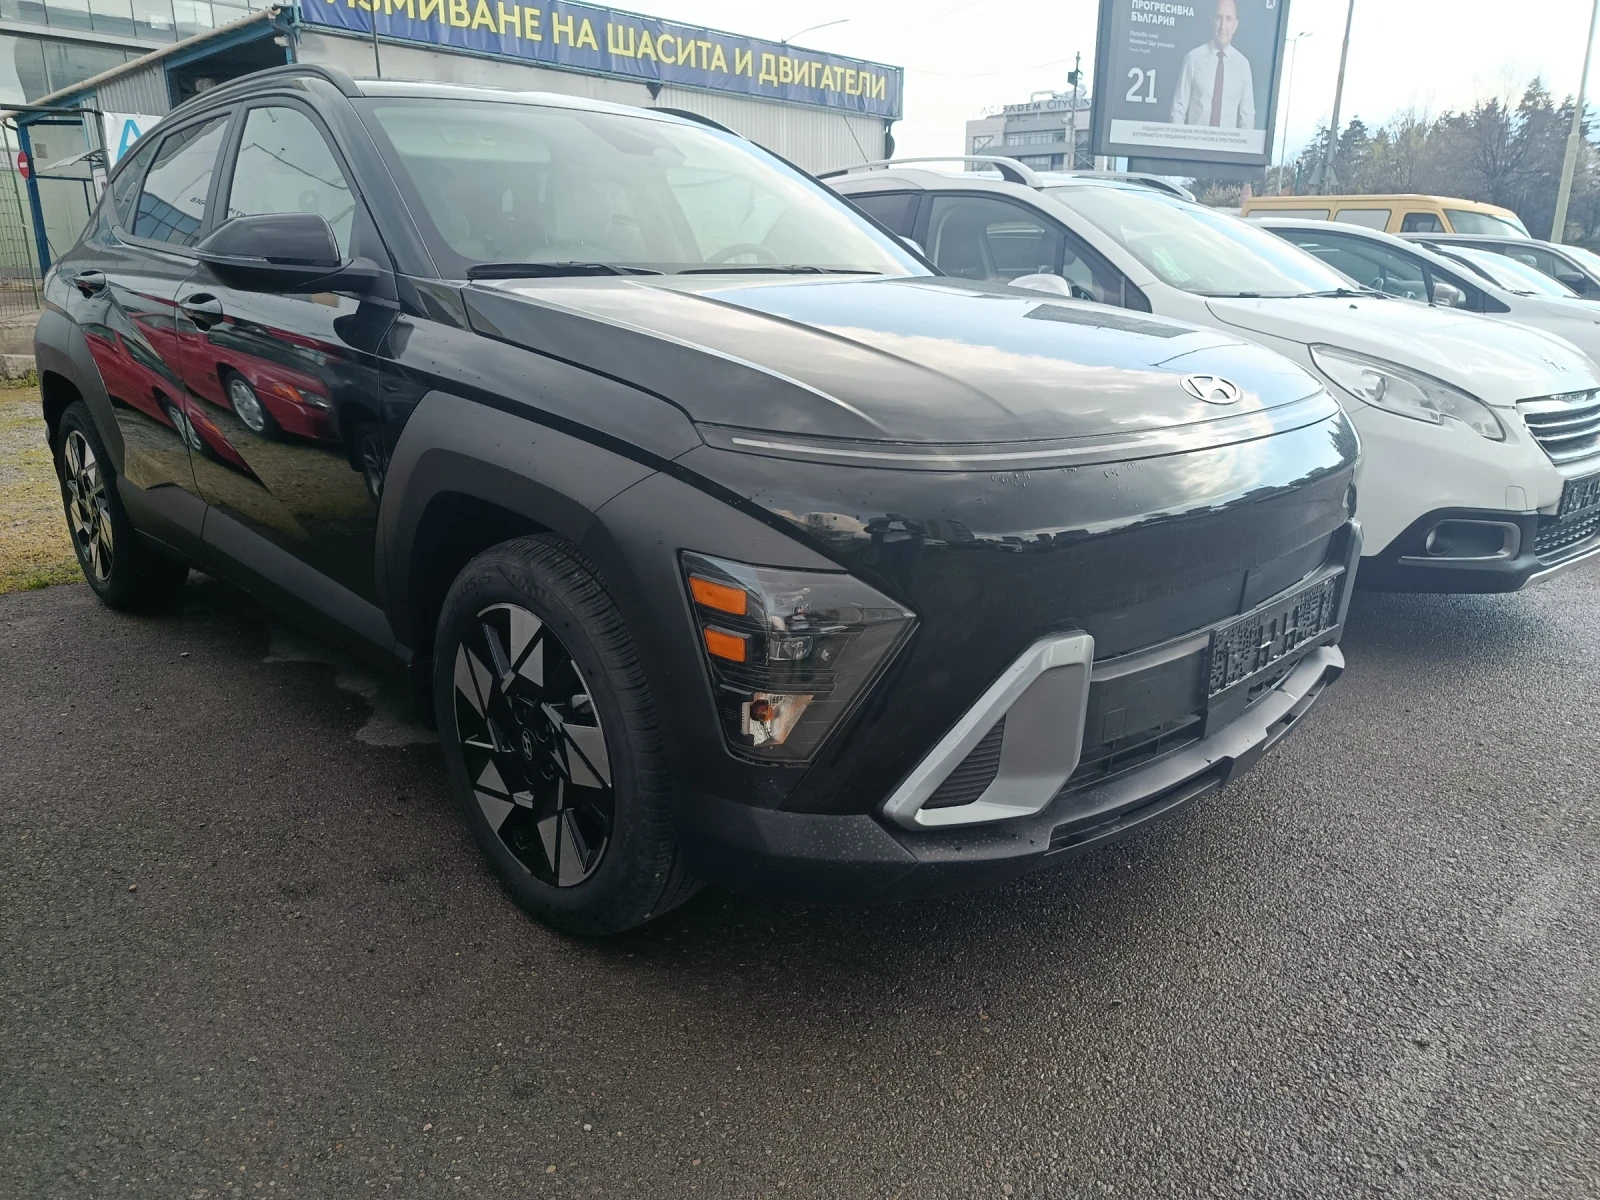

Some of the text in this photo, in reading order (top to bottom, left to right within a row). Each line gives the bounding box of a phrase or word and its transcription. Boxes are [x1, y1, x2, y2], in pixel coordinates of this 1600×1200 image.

[1131, 0, 1194, 17] ПРОГРЕСИВНА
[1131, 11, 1175, 26] БЪЛГАРИЯ
[325, 0, 886, 101] МИВАНЕ НА ШАСИТА И ДВИГАТЕЛИ
[1125, 67, 1157, 104] 21
